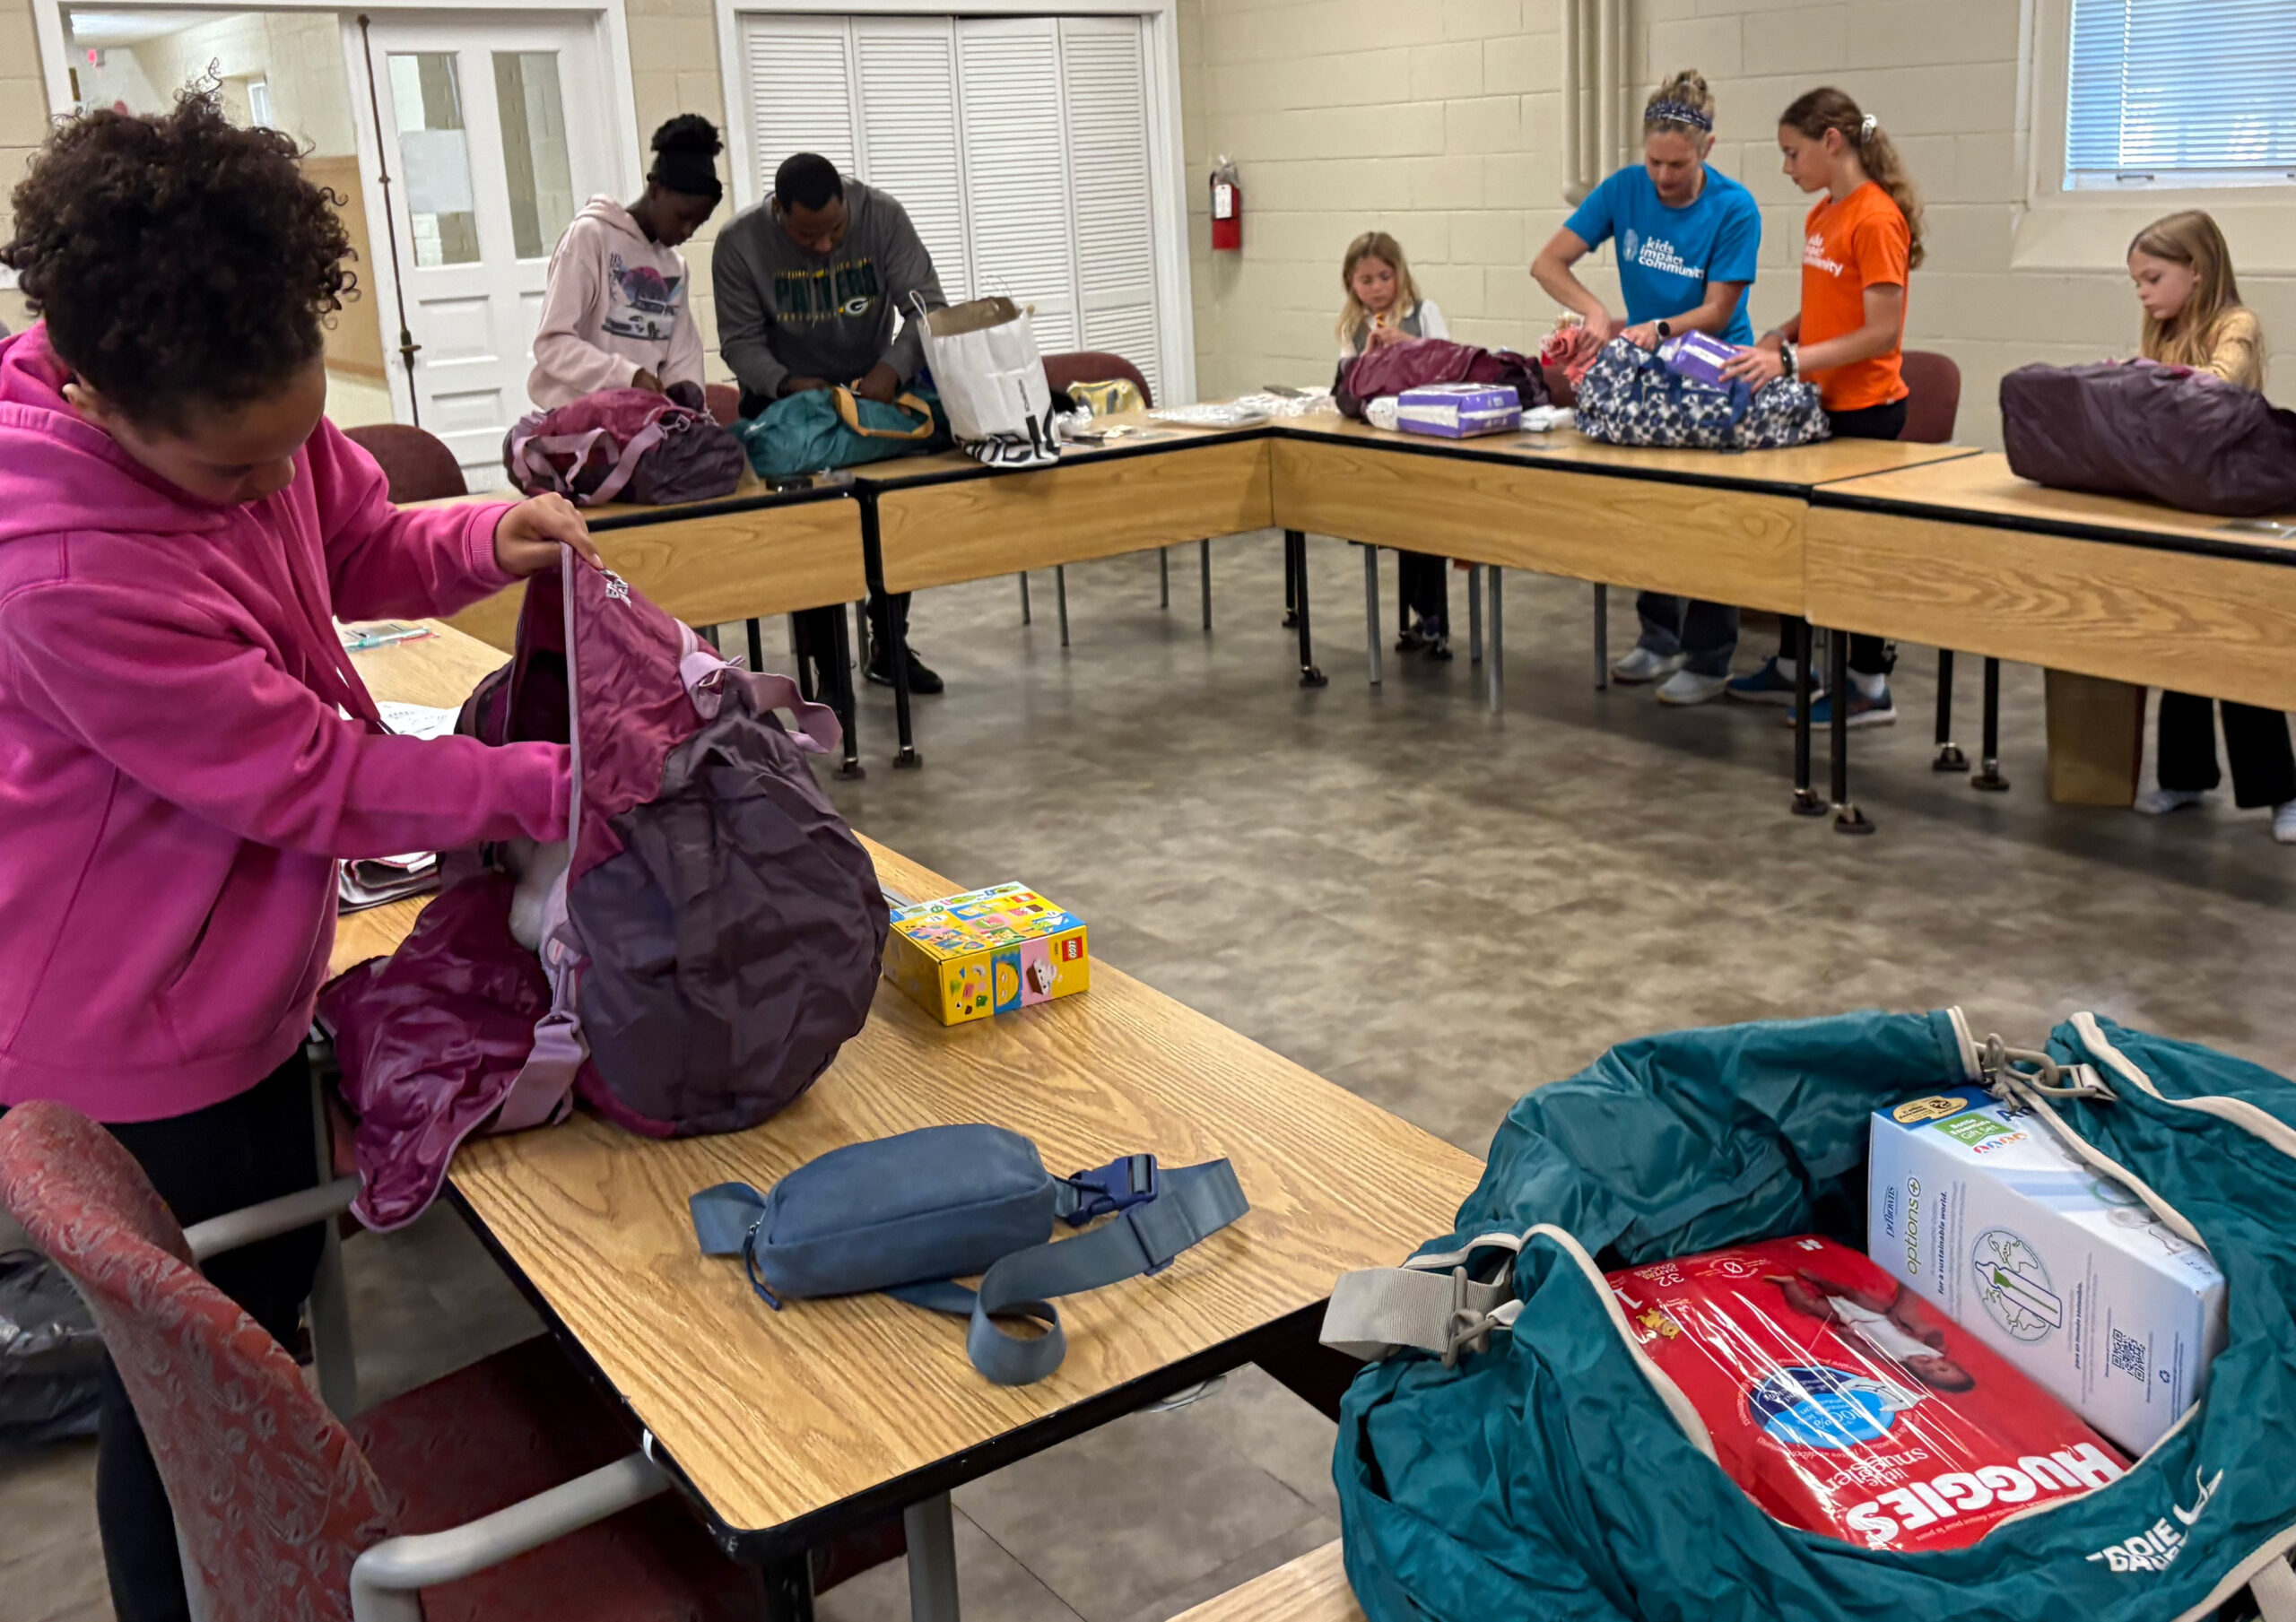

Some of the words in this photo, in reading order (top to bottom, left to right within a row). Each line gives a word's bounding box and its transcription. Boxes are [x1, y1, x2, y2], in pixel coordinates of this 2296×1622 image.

[1639, 244, 1684, 265] impact
[1647, 236, 1674, 255] kids
[1639, 256, 1705, 279] communit
[1068, 941, 1077, 959] LEGO
[1961, 1129, 1983, 1140] Gift
[1937, 1220, 1945, 1272] sustainable
[1654, 1273, 1685, 1287] 32
[1612, 1287, 1643, 1309] 1
[1819, 1447, 1929, 1496] snuggler
[1845, 1442, 2126, 1544] HUGGIES
